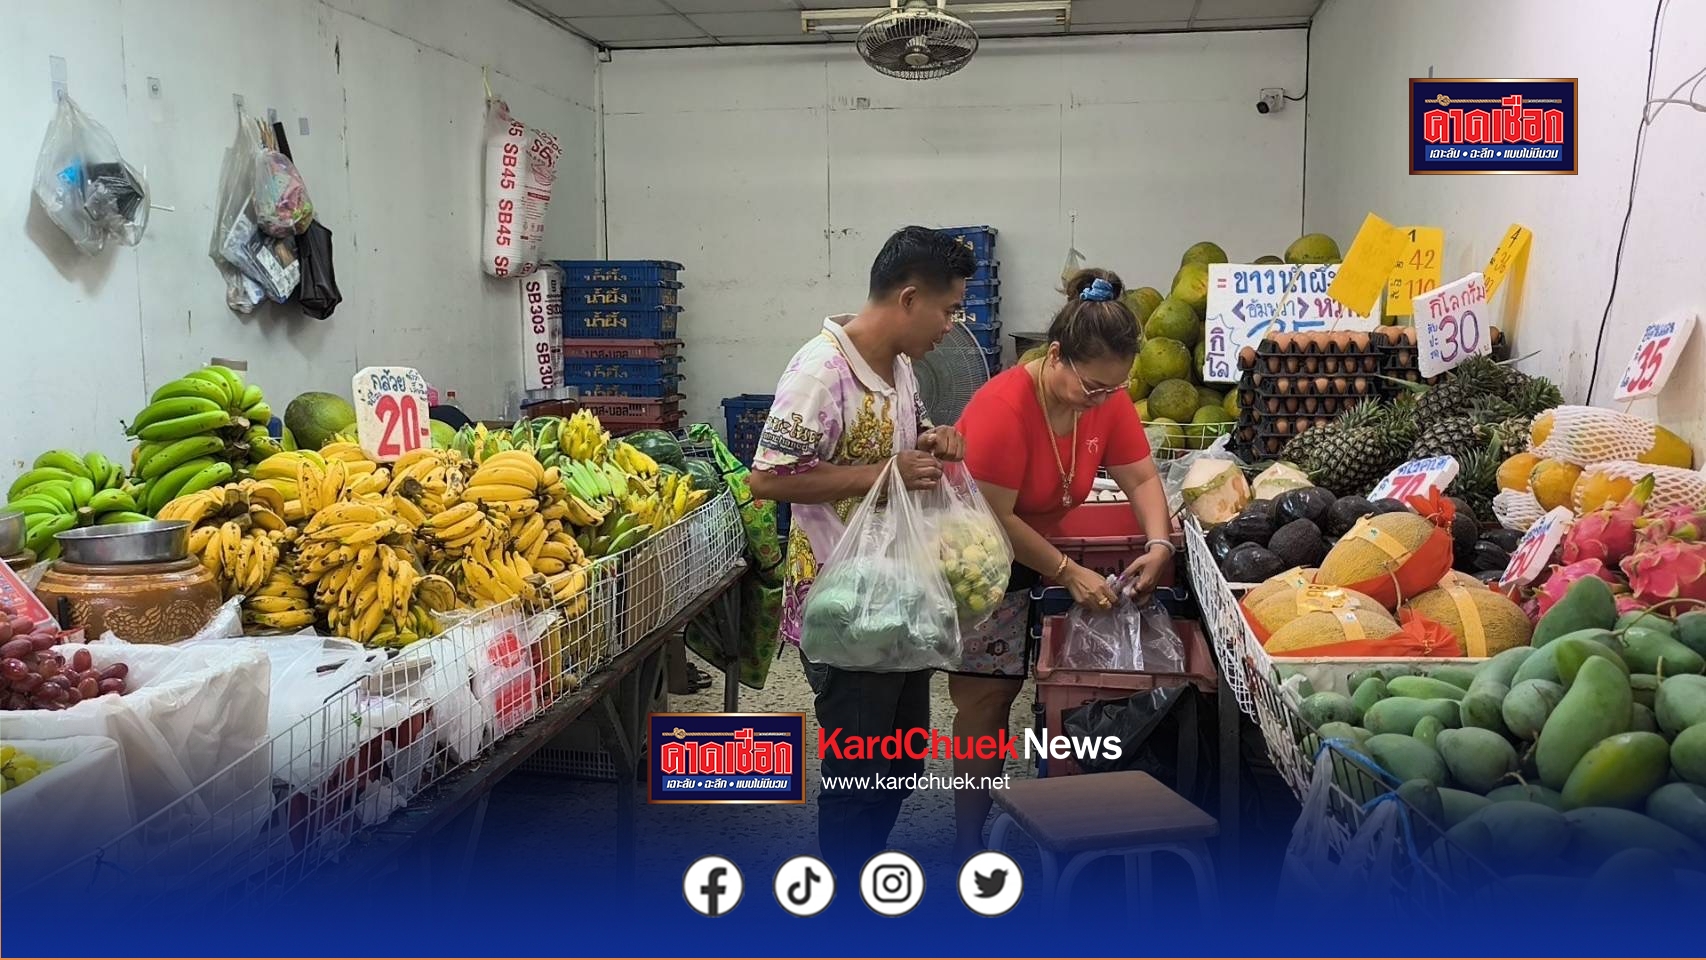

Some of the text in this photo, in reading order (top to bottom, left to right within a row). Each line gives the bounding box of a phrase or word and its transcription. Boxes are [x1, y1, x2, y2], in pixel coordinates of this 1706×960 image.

[500, 143, 518, 189] SB45
[496, 199, 513, 246] SB45
[1409, 249, 1435, 270] 42
[583, 287, 628, 304] น้ำผึ้ง
[1429, 281, 1486, 319] กิโลกรัม
[526, 281, 545, 334] SB303
[536, 342, 555, 389] SB30
[583, 312, 628, 328] น้ำผึ้ง
[1439, 310, 1479, 362] 30
